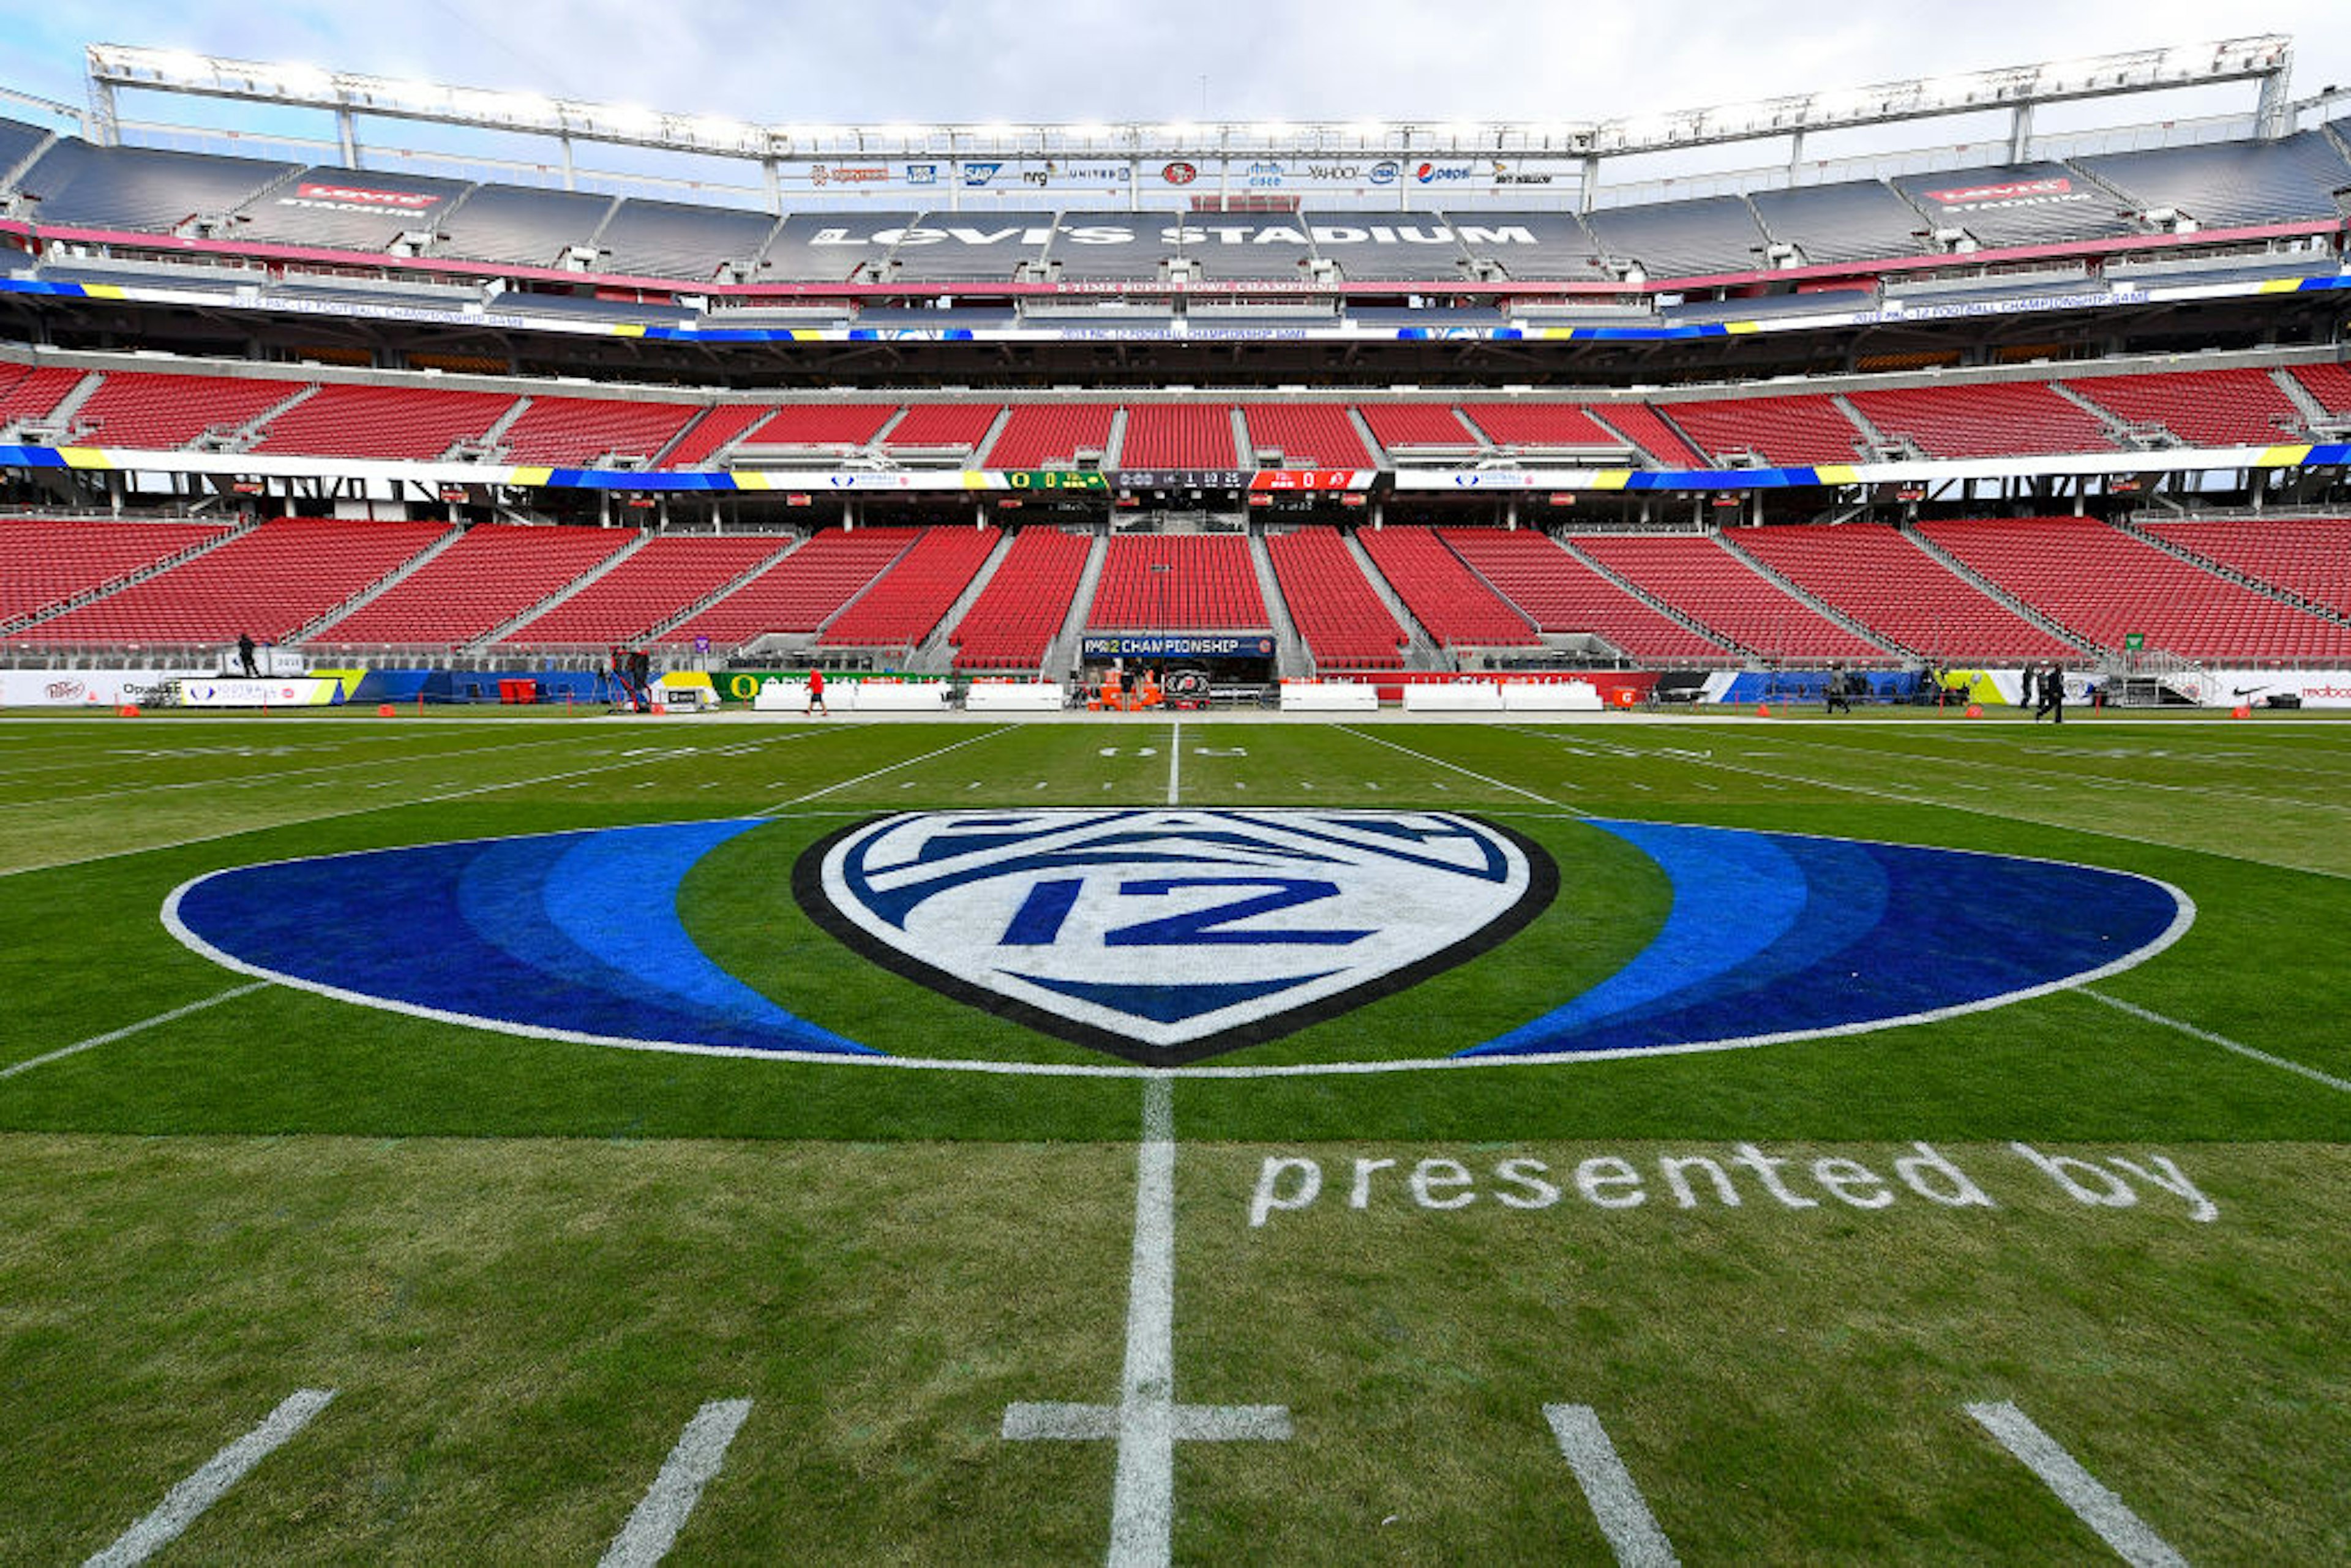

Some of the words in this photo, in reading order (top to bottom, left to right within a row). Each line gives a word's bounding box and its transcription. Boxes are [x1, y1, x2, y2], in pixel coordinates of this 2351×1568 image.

[965, 167, 995, 182] SAP
[1024, 171, 1048, 185] nrg
[1070, 170, 1116, 179] UNITED
[1308, 166, 1359, 180] YAHOO!
[1436, 168, 1469, 181] pepsi
[1161, 226, 1538, 244] STADIUM
[1184, 282, 1229, 293] BOWL
[1235, 282, 1340, 293] CHAMPIONS
[862, 811, 1491, 892] PAC
[997, 877, 1382, 947] 12
[1249, 1142, 1999, 1227] presented
[2010, 1142, 2218, 1223] by
